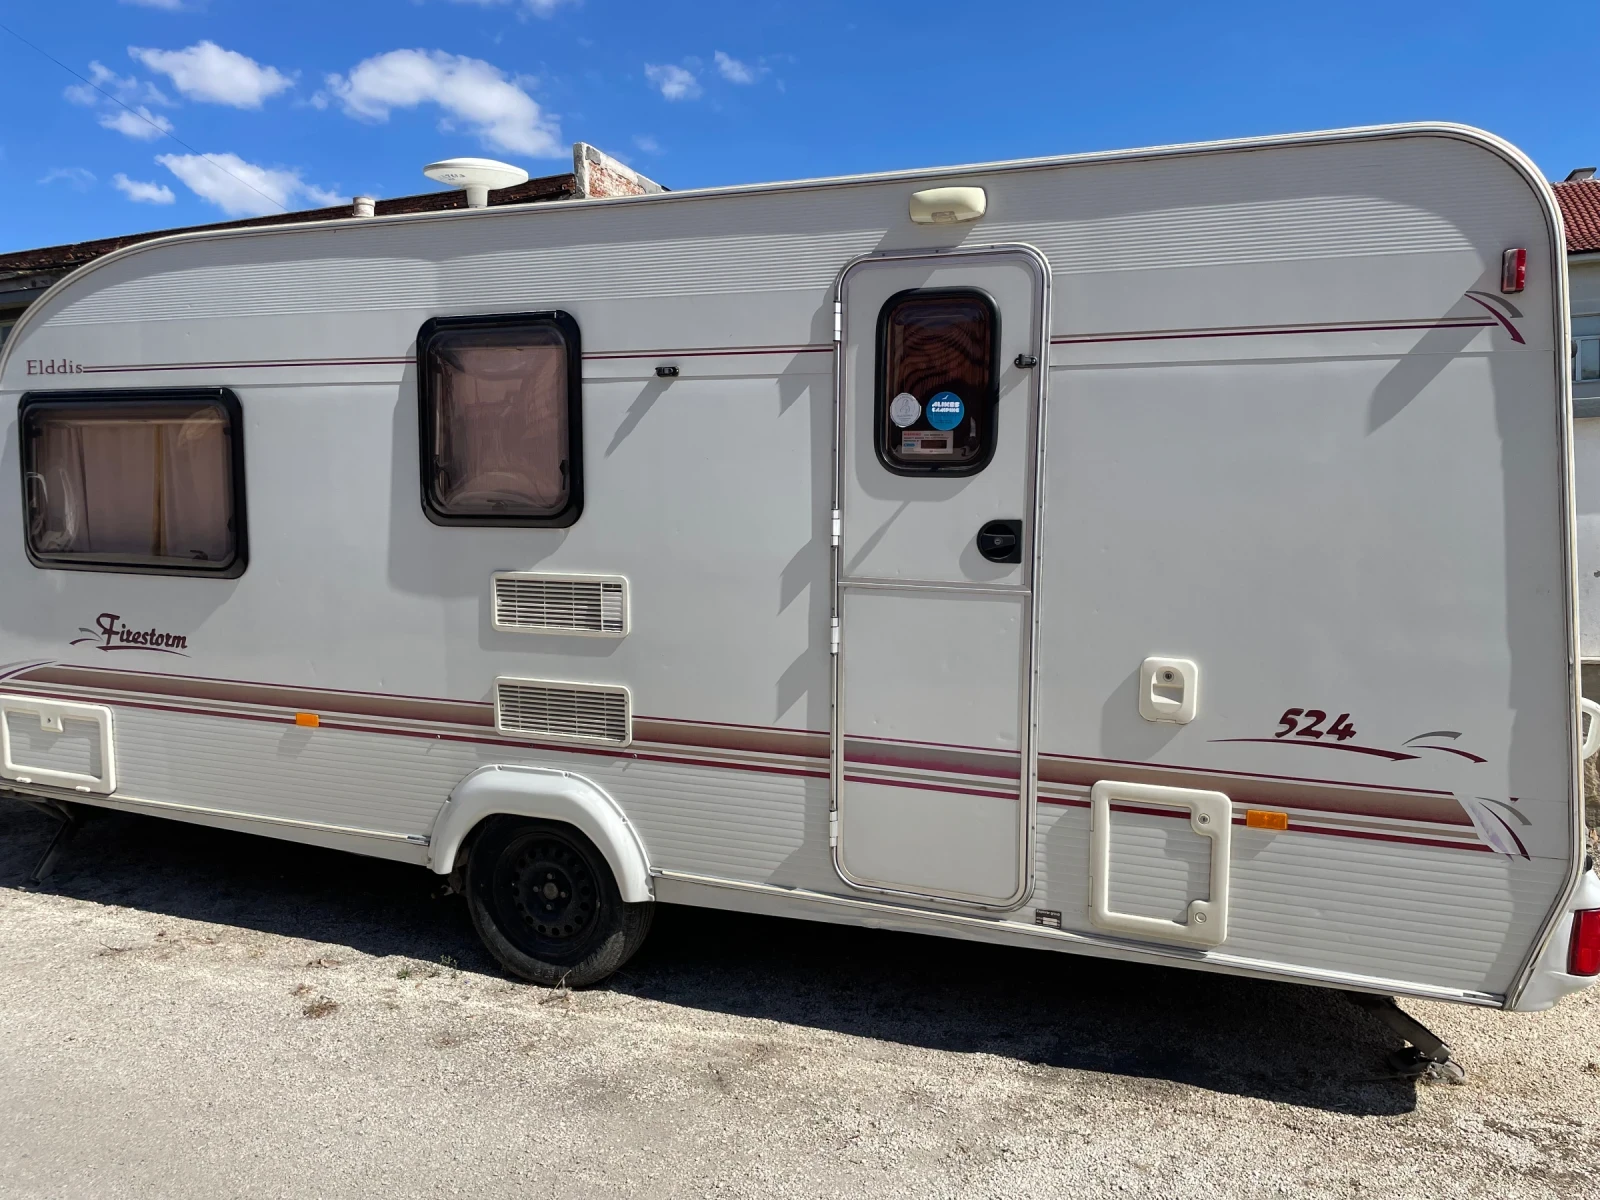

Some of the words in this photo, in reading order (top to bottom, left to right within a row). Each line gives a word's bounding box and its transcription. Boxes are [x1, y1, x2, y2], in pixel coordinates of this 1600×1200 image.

[26, 359, 83, 375] Elddis
[96, 613, 188, 649] Firestorm
[1275, 707, 1357, 741] 524
